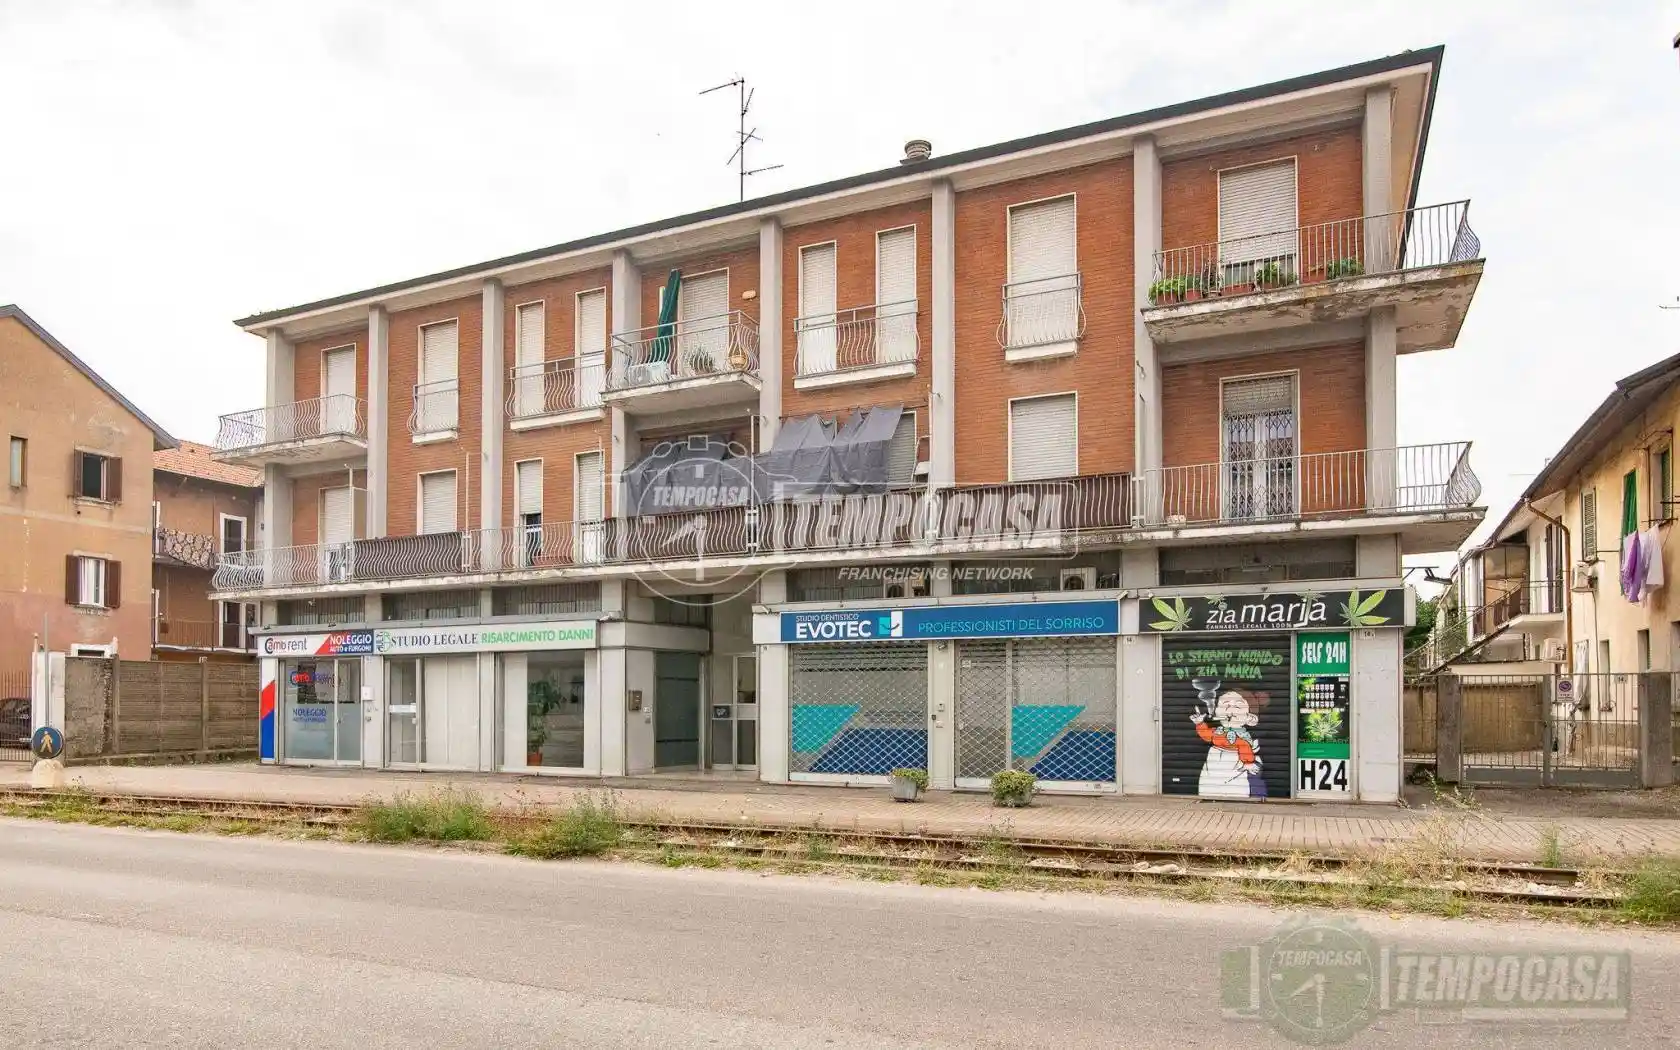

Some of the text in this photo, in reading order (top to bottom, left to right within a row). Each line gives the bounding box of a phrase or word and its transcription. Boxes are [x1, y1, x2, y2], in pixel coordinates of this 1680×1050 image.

[821, 613, 859, 621] DENTISTICO
[1206, 602, 1236, 624] zia
[795, 620, 872, 639] EVOTEC
[918, 616, 1104, 633] PROFESSIONISTI DEL SORRISO
[330, 634, 372, 645] NOLEGGIO
[391, 633, 431, 647] STUDIO
[434, 632, 479, 646] LEGALE
[481, 629, 556, 645] RISARCIMENTO
[558, 628, 594, 642] DANNI
[329, 645, 344, 653] AUTO
[1168, 652, 1184, 665] LO
[1238, 650, 1283, 665] MONDO
[1301, 641, 1347, 664] SELF 24H
[1196, 664, 1219, 677] ZIA
[1225, 663, 1262, 680] MARIA
[1300, 759, 1348, 791] H24
